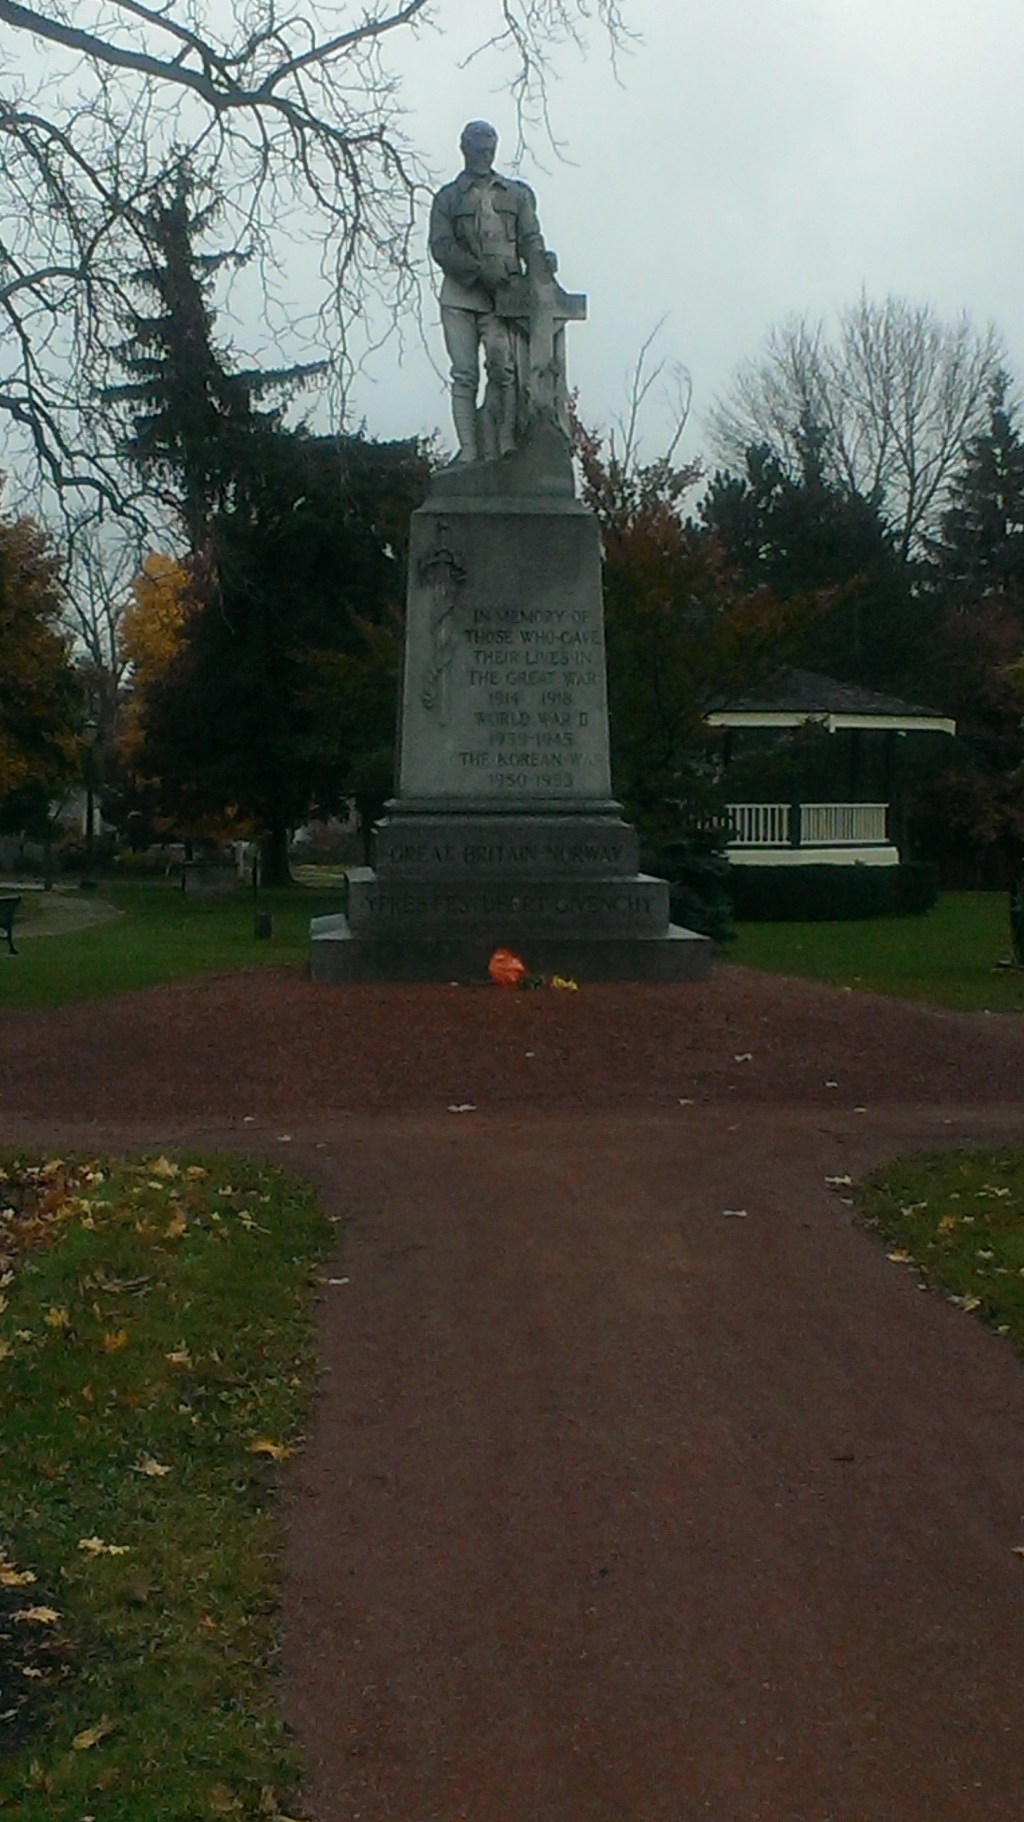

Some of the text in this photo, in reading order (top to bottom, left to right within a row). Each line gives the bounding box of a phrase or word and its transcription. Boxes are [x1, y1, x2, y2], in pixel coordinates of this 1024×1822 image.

[473, 607, 491, 624] IN
[463, 628, 513, 645] THOSE
[473, 649, 519, 665] THEIR
[574, 650, 593, 666] IN
[468, 669, 598, 687] THE GREAT WAR
[474, 711, 530, 727] WORLD
[536, 711, 571, 727] WAR
[458, 751, 489, 767] THE
[497, 752, 563, 767] KOREAN
[388, 844, 452, 864] GREAT
